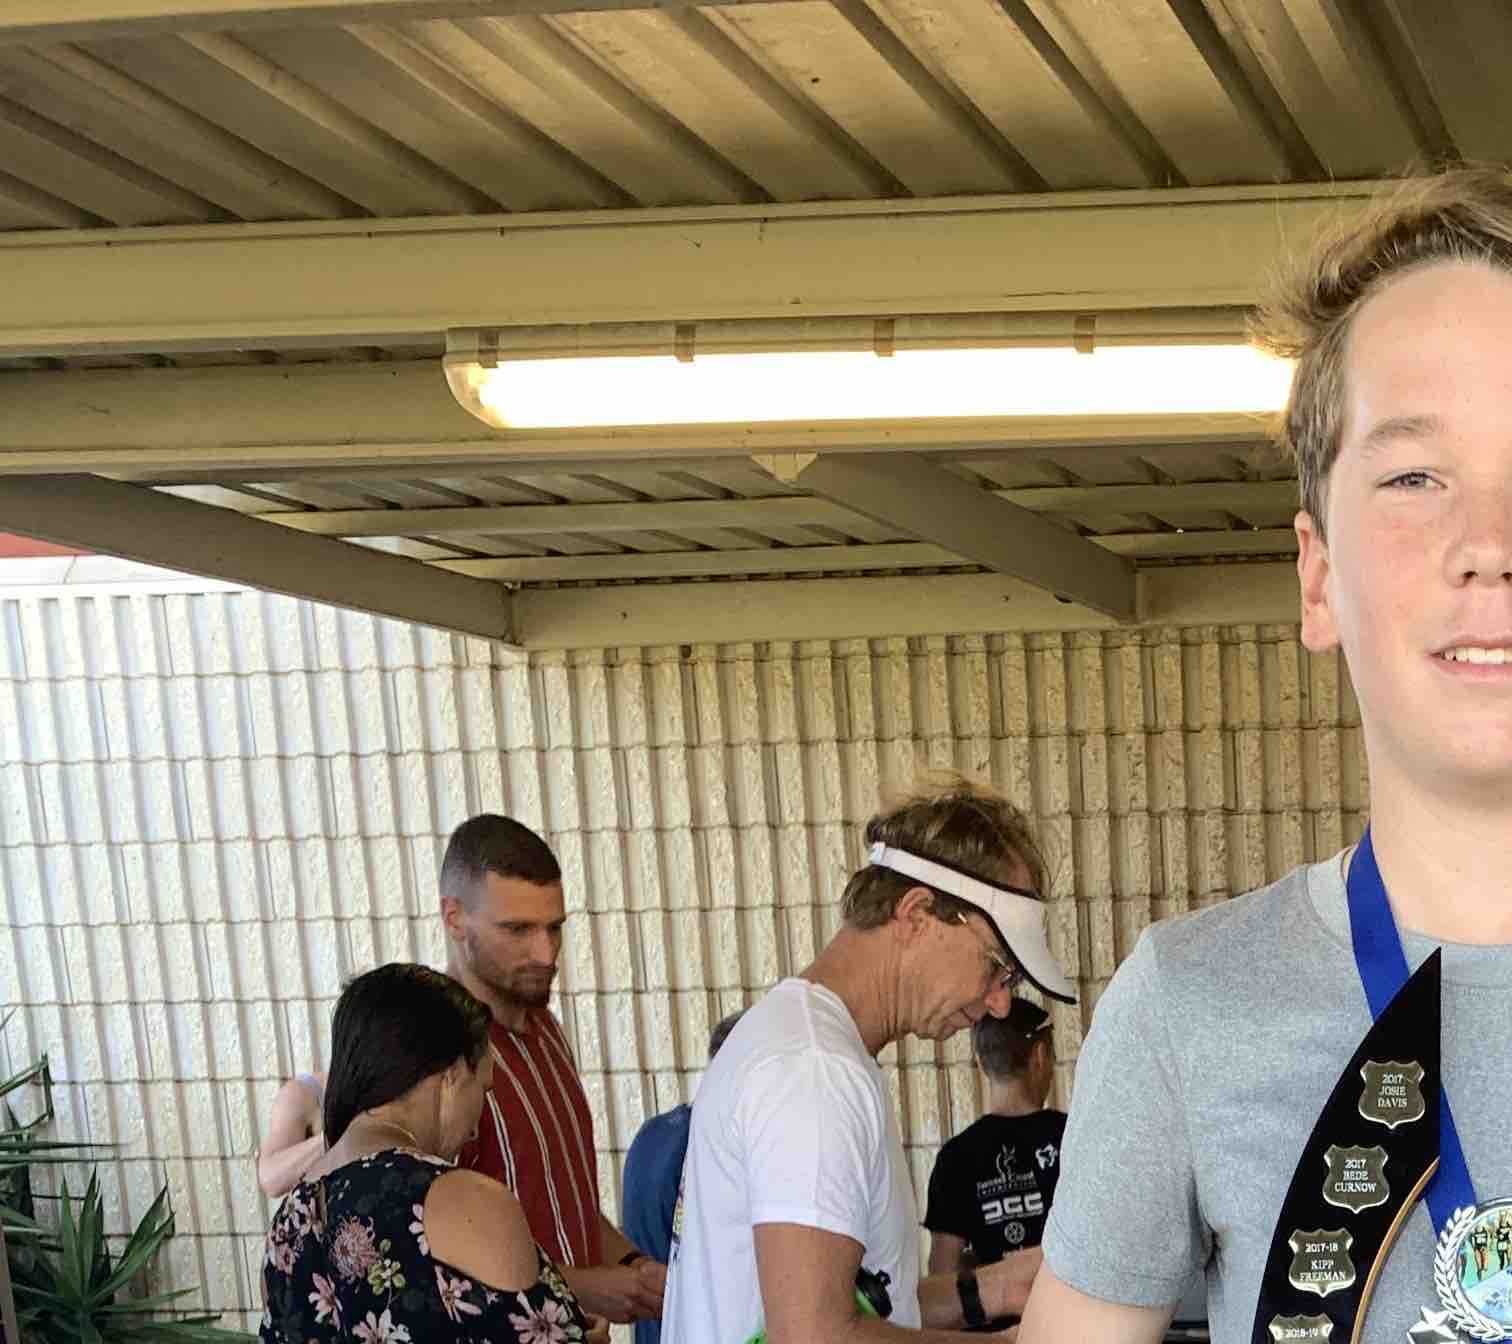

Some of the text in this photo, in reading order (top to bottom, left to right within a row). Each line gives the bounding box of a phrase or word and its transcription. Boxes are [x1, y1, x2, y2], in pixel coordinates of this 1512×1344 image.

[1382, 1073, 1404, 1084] 2017
[1379, 1085, 1406, 1096] JOSIE
[1377, 1097, 1408, 1108] DAVIS
[1344, 1159, 1367, 1169] 2017
[1334, 1182, 1377, 1193] CURNOW
[1299, 1271, 1347, 1281] FREEMAN
